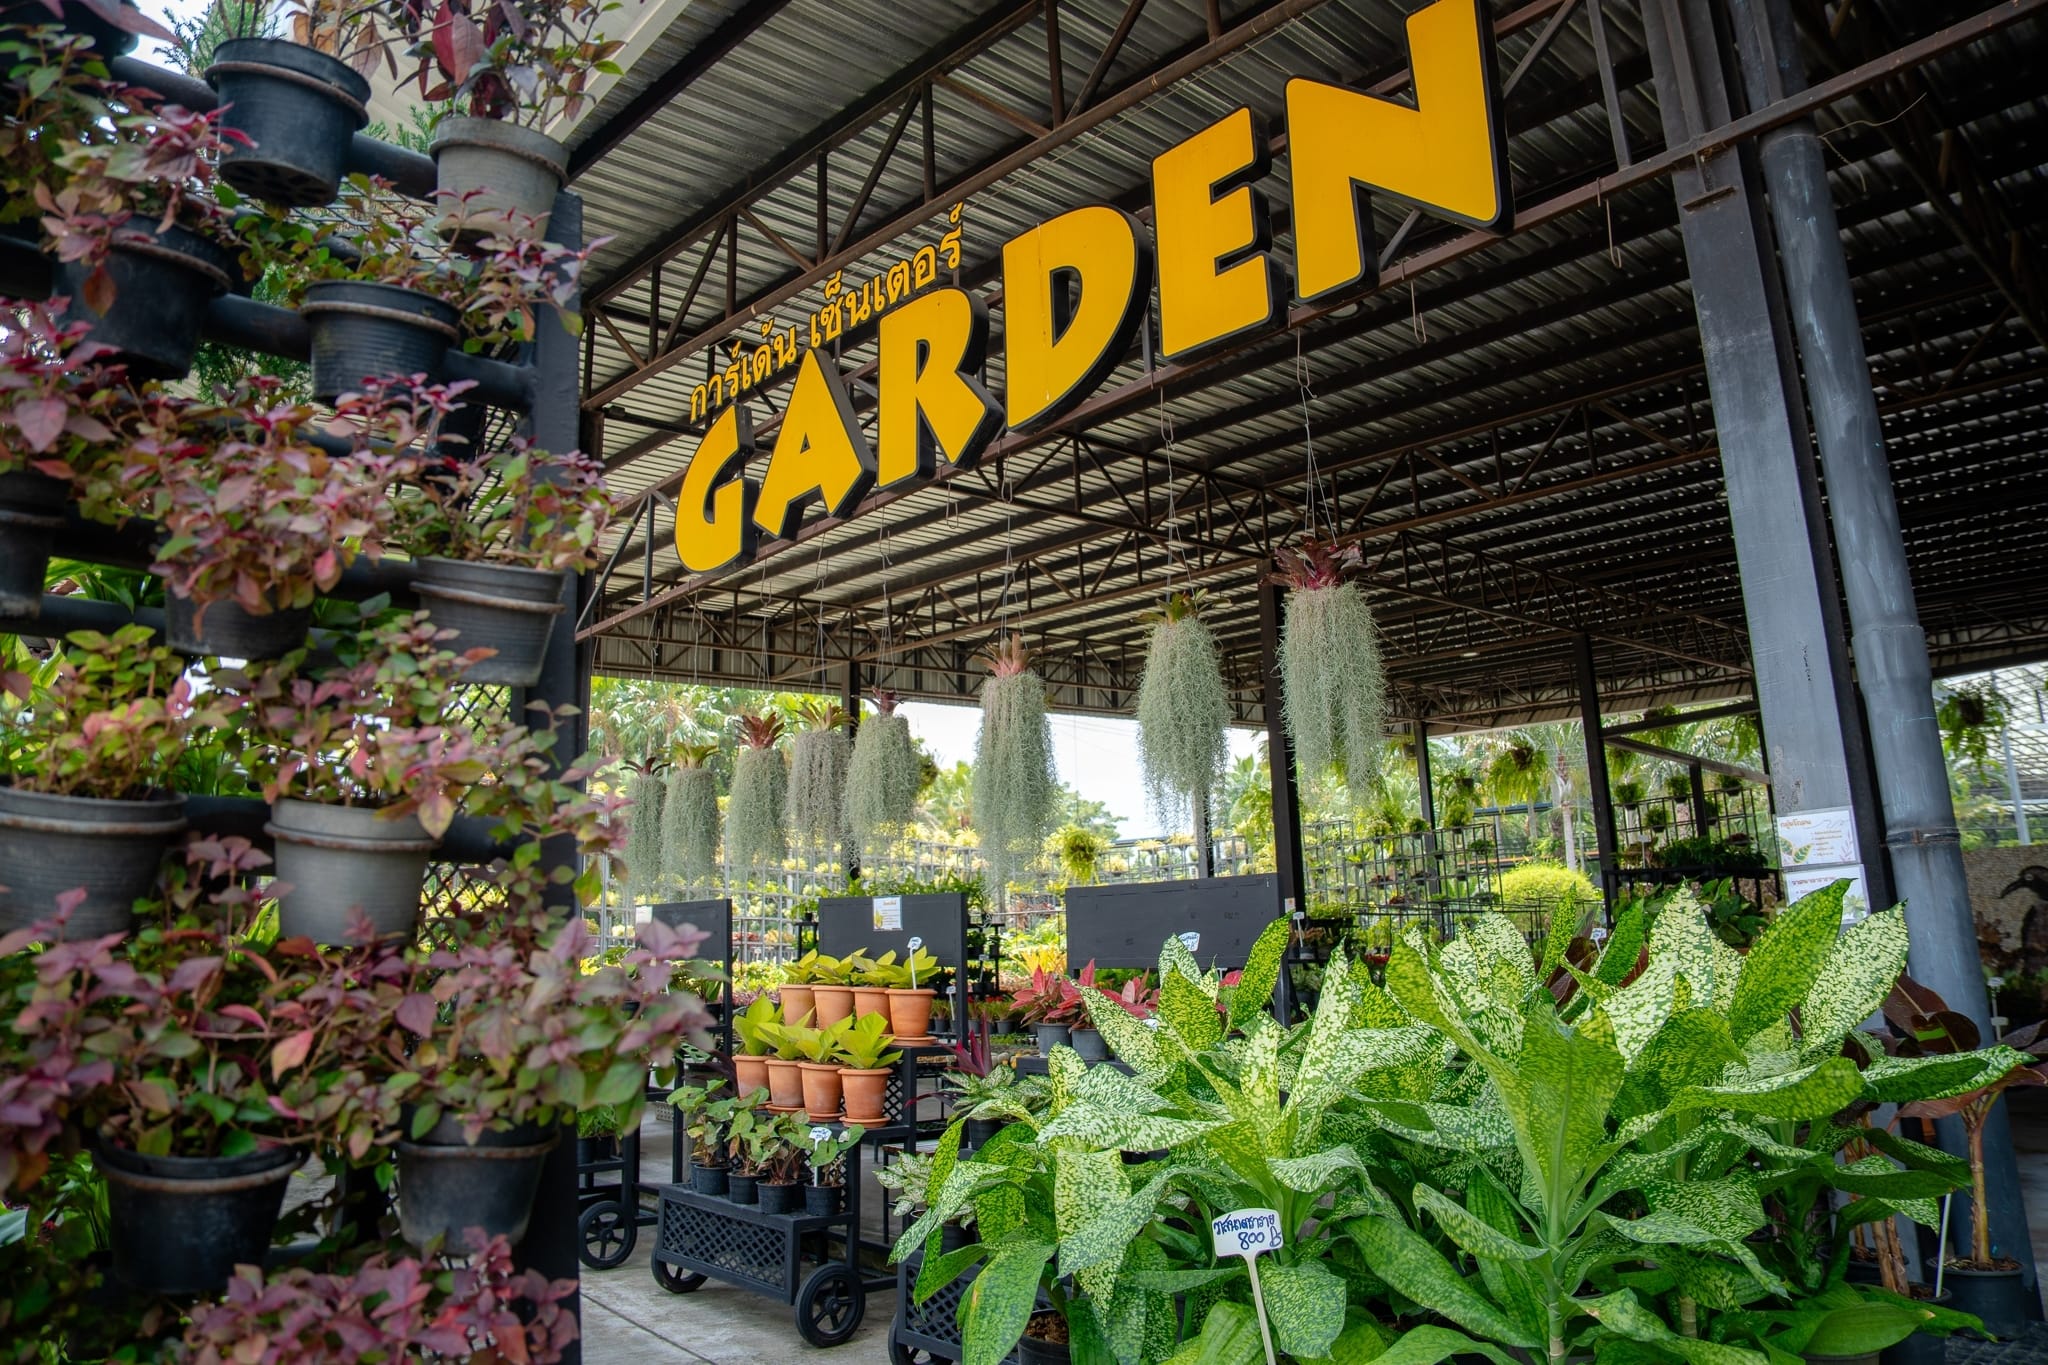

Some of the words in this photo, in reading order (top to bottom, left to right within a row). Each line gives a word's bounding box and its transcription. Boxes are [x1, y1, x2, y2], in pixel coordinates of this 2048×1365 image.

[674, 0, 1511, 574] GARDEN
[690, 318, 797, 424] การ์เด้น
[809, 201, 964, 350] เซ็นเตอร์
[1237, 1231, 1265, 1250] 800
